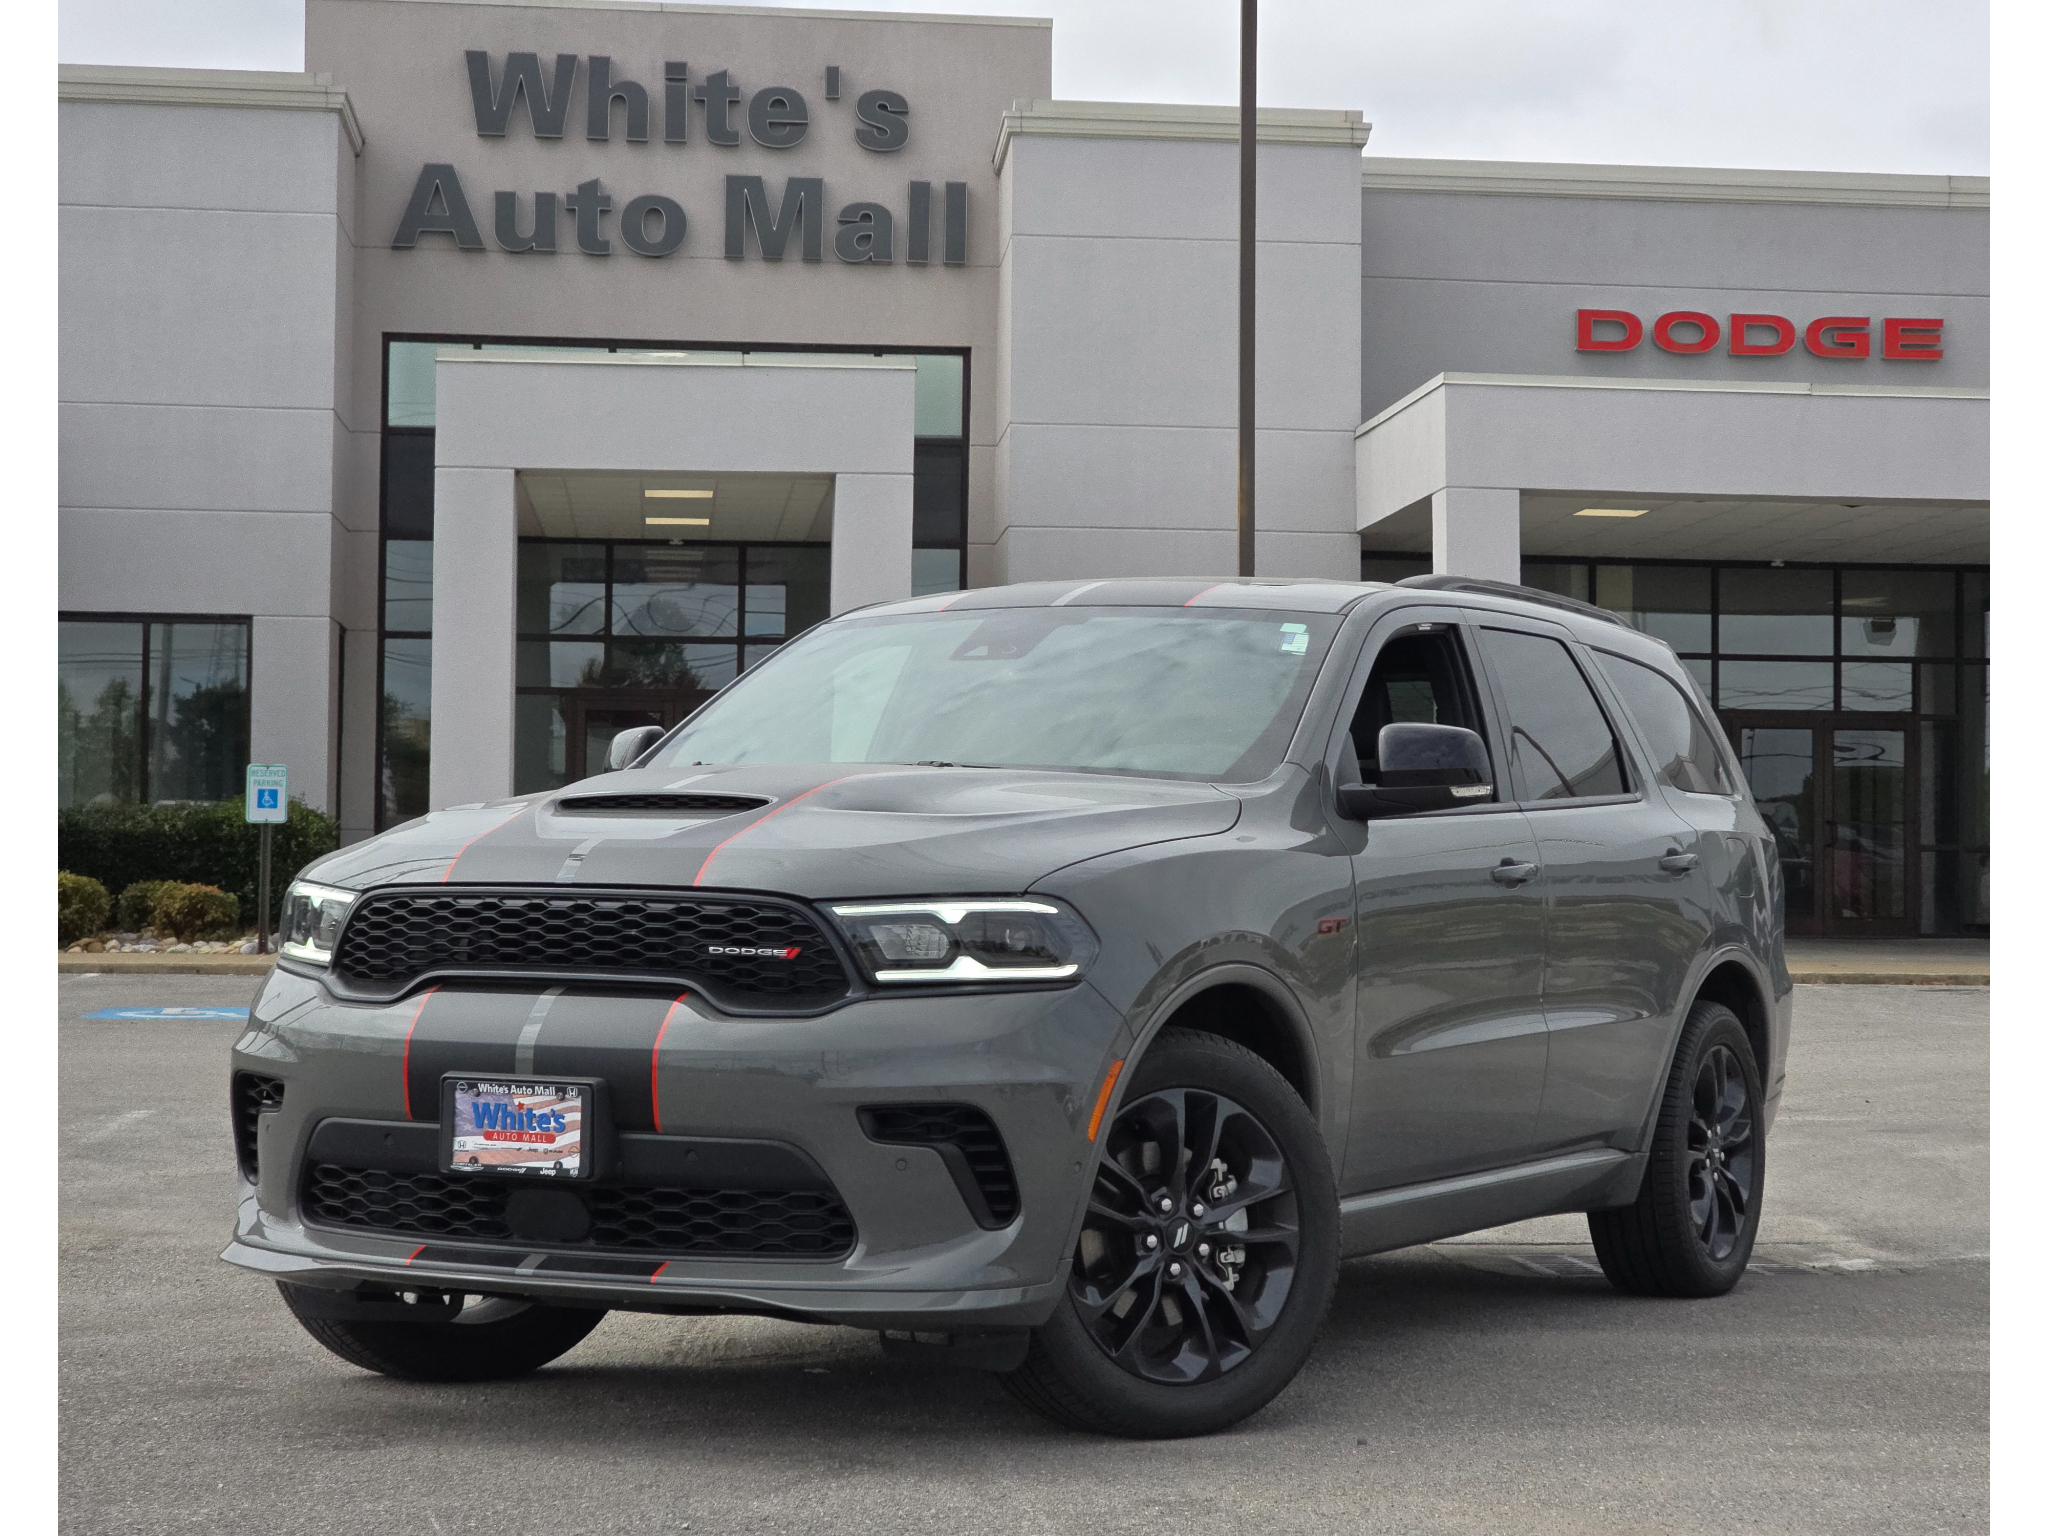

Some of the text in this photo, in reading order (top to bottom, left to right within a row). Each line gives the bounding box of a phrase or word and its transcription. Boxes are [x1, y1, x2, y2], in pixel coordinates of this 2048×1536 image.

[464, 49, 910, 151] White's
[391, 162, 968, 265] Auto Mall
[1575, 308, 1944, 360] DODGE
[250, 769, 286, 777] RESERVED
[253, 779, 283, 787] PARKING
[1317, 918, 1347, 935] GT
[708, 946, 788, 956] DODGE
[477, 1083, 556, 1096] White's Auto Mall
[472, 1101, 566, 1133] White's
[492, 1131, 547, 1143] AUTO MALL
[540, 1167, 557, 1176] Jeep
